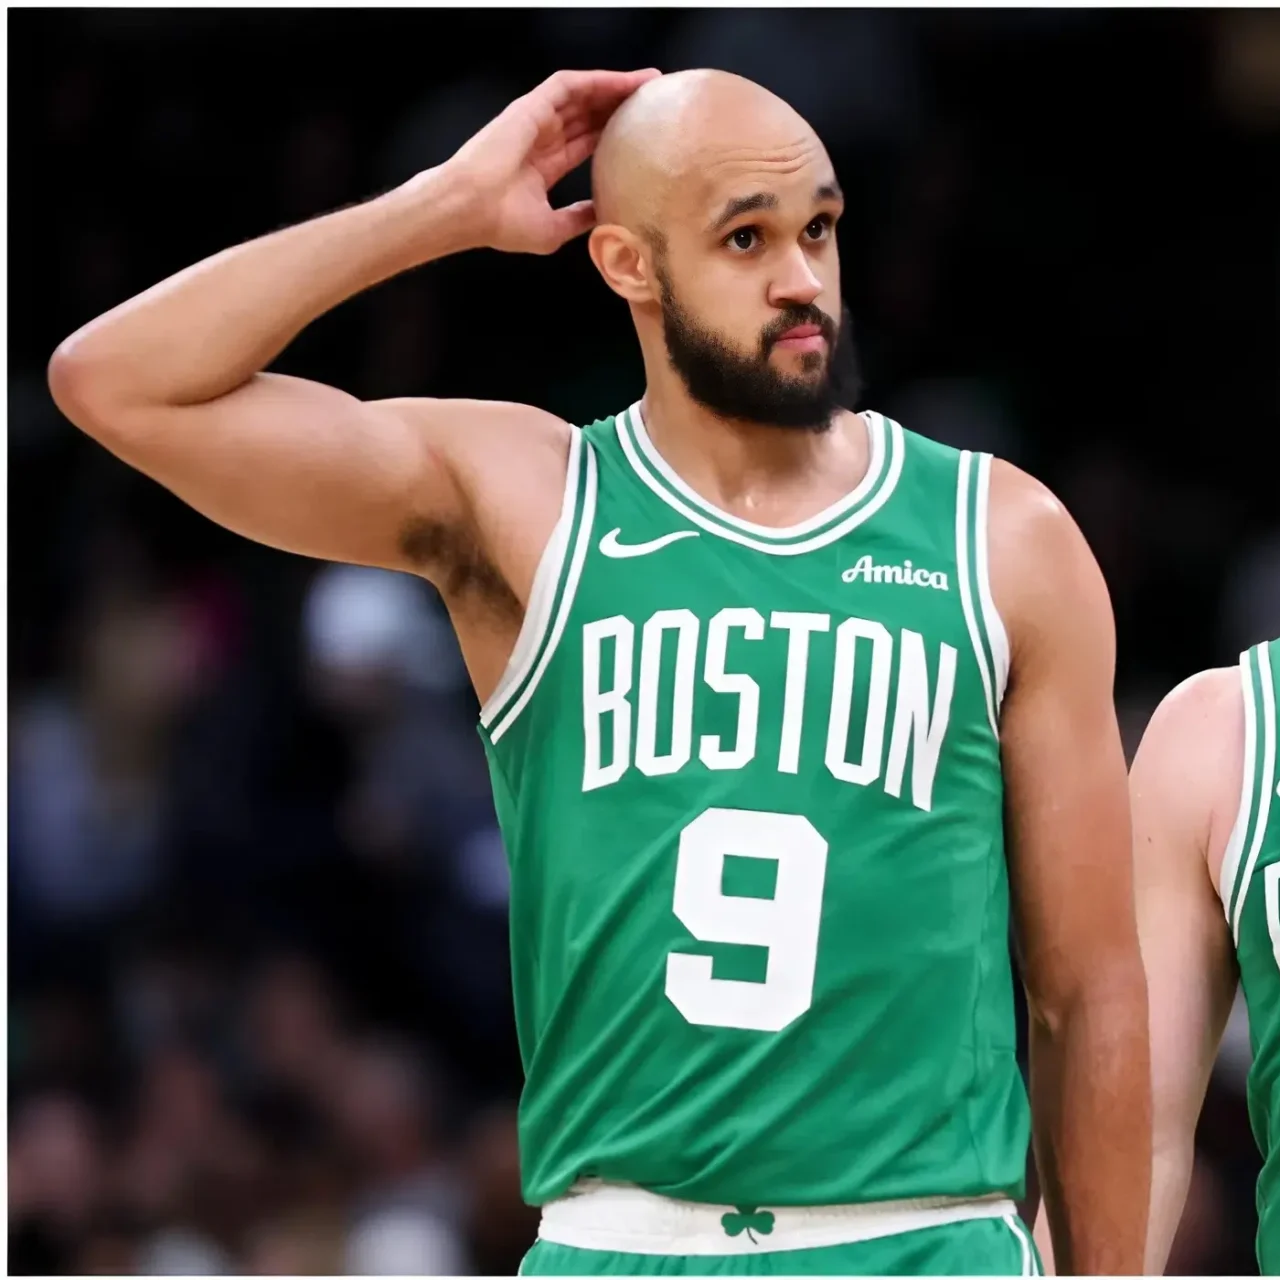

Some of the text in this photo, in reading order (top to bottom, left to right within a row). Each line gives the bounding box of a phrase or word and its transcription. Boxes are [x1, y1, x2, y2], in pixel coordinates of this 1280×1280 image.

[842, 555, 949, 592] Amica
[582, 607, 958, 812] BOSTON
[665, 807, 829, 1032] 9
